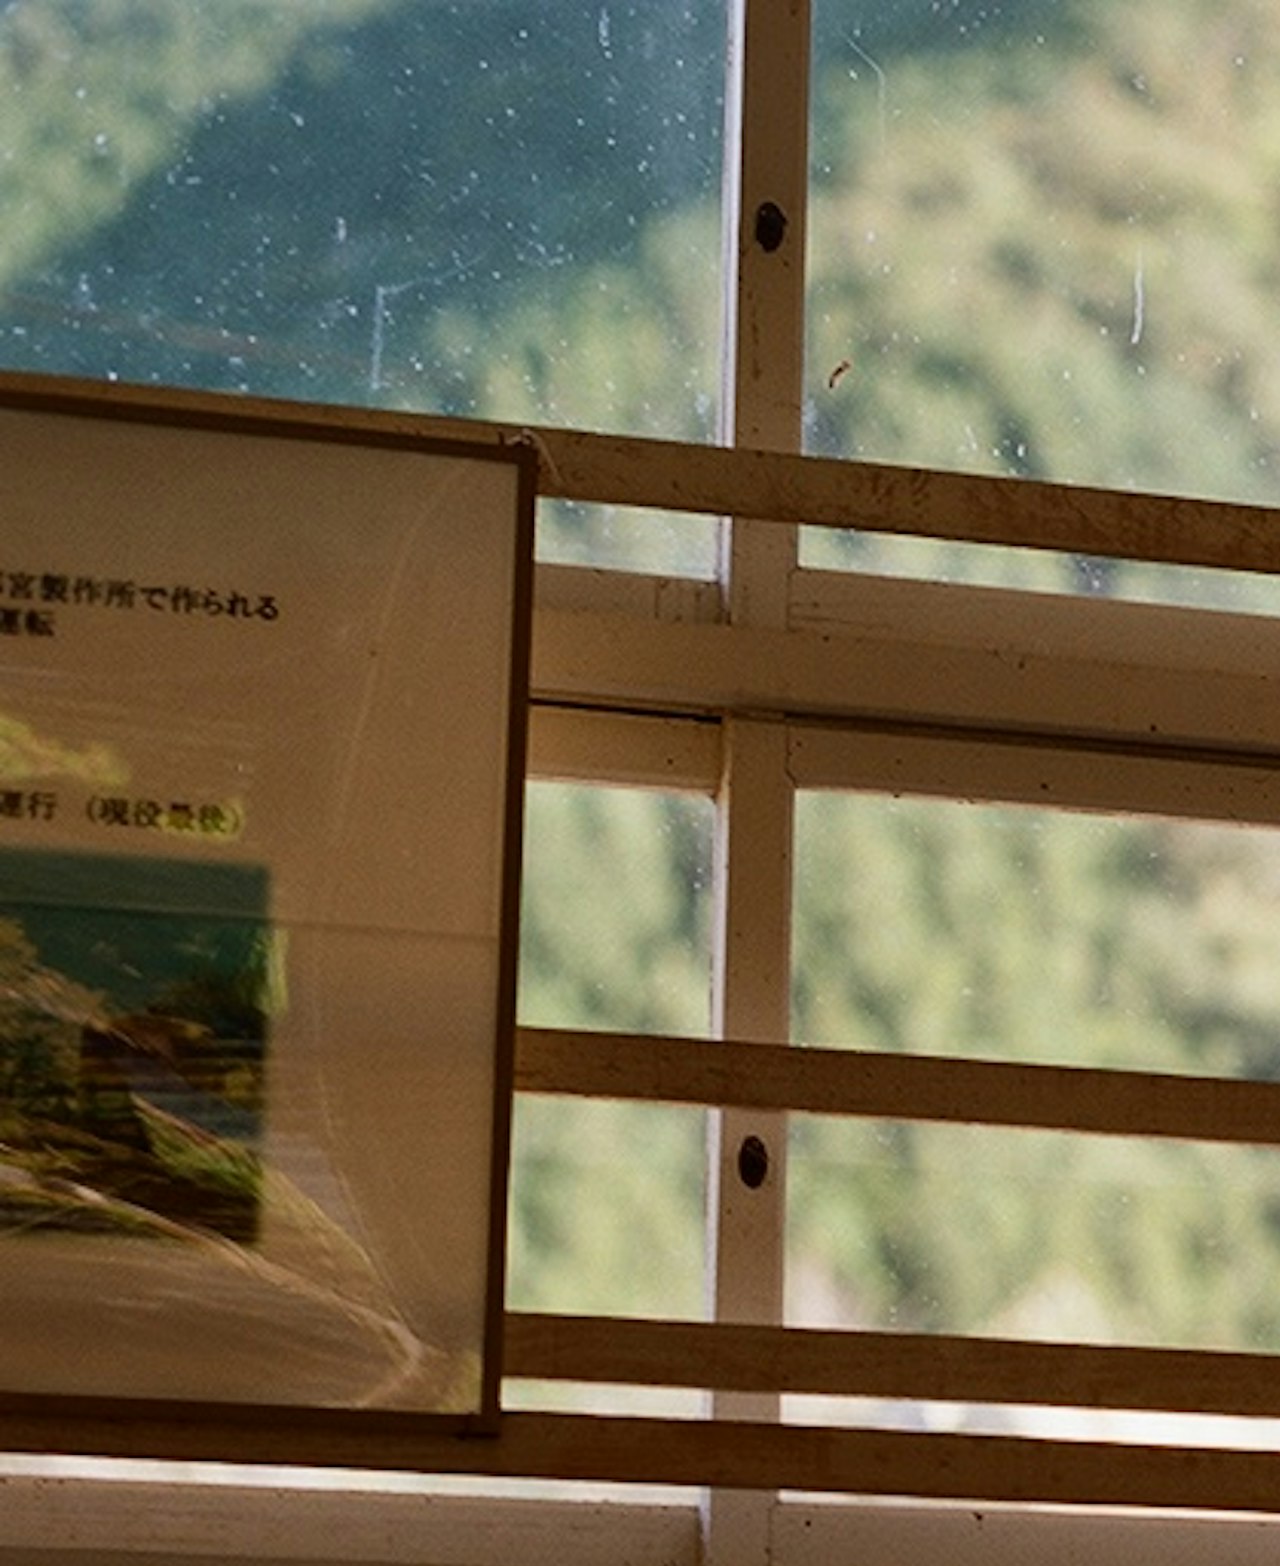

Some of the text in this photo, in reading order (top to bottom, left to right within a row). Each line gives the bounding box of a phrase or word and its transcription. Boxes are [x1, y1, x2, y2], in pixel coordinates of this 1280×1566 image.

[0, 571, 279, 620] 宮製作所で作られる
